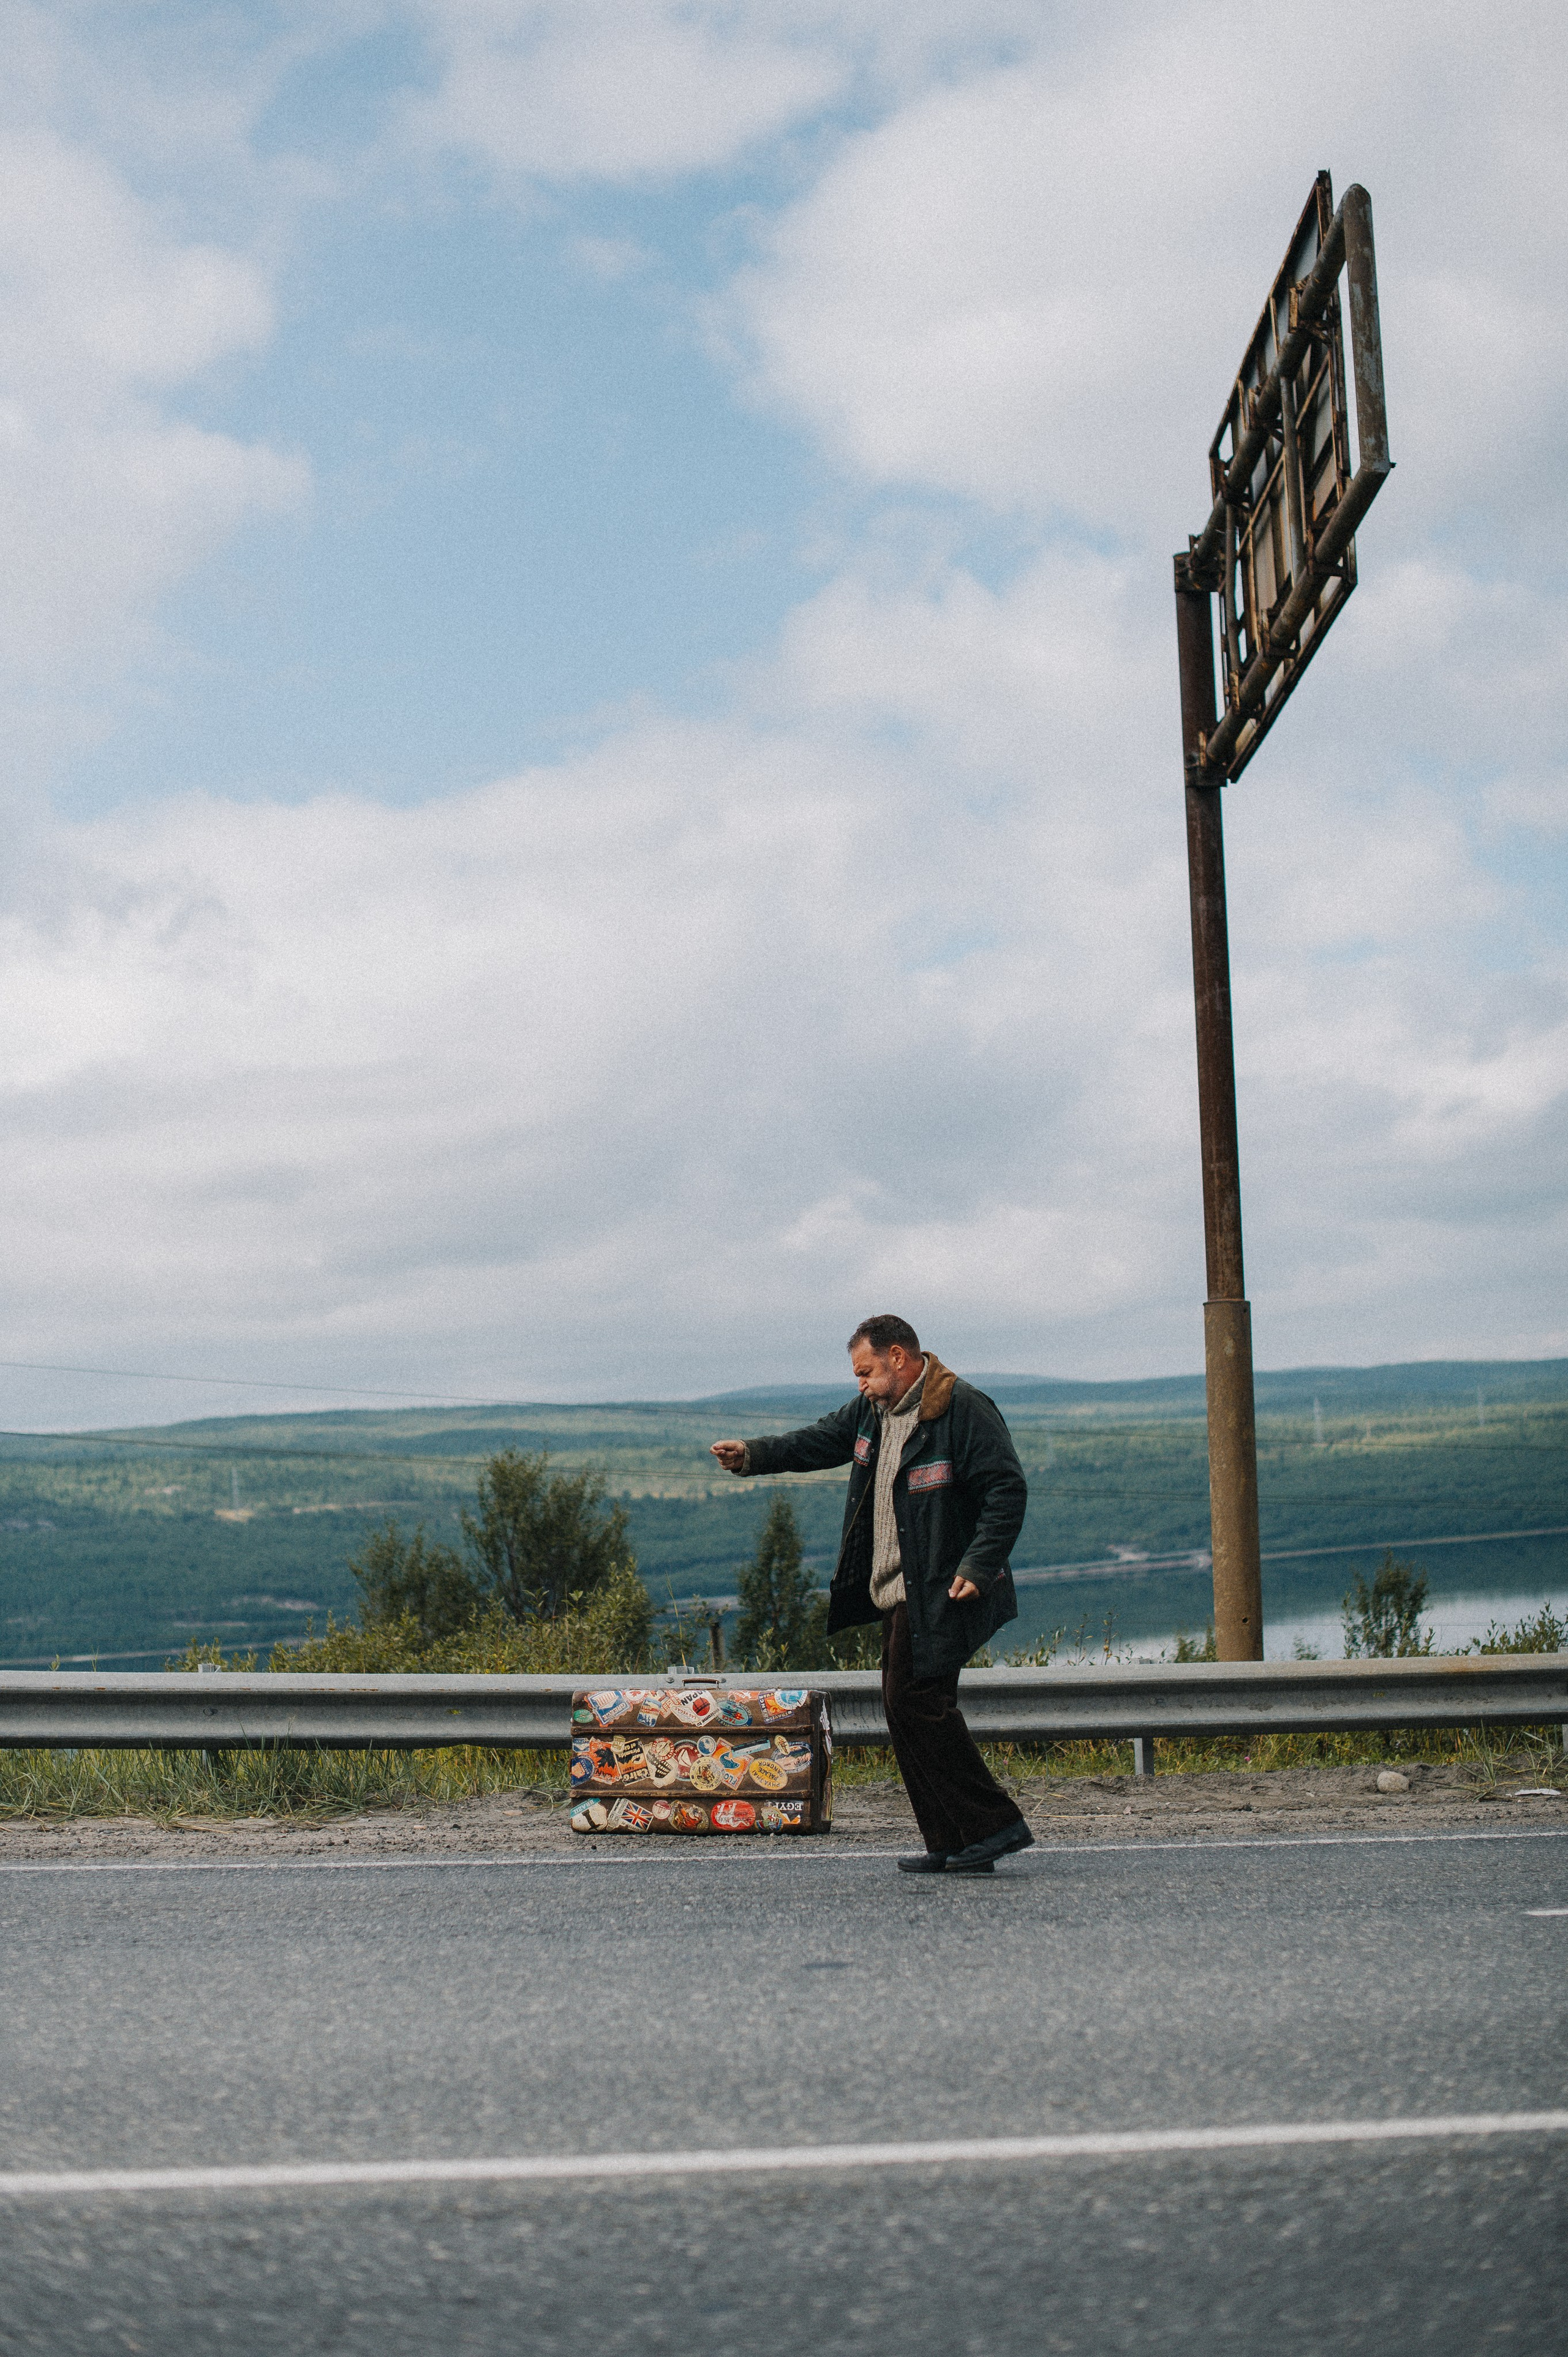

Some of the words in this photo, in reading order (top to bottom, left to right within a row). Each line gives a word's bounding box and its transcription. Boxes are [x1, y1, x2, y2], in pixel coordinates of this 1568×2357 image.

[602, 1703, 625, 1721] GREECE
[674, 1706, 688, 1715] VEGAS
[722, 1714, 736, 1724] TACA
[618, 1748, 641, 1758] Piramids
[623, 1768, 648, 1781] Cairo
[758, 1761, 784, 1778] BANGKOK
[758, 1767, 778, 1781] PALACE
[723, 1773, 738, 1786] FLO
[752, 1770, 763, 1783] THAI
[572, 1800, 594, 1814] BRAZIL
